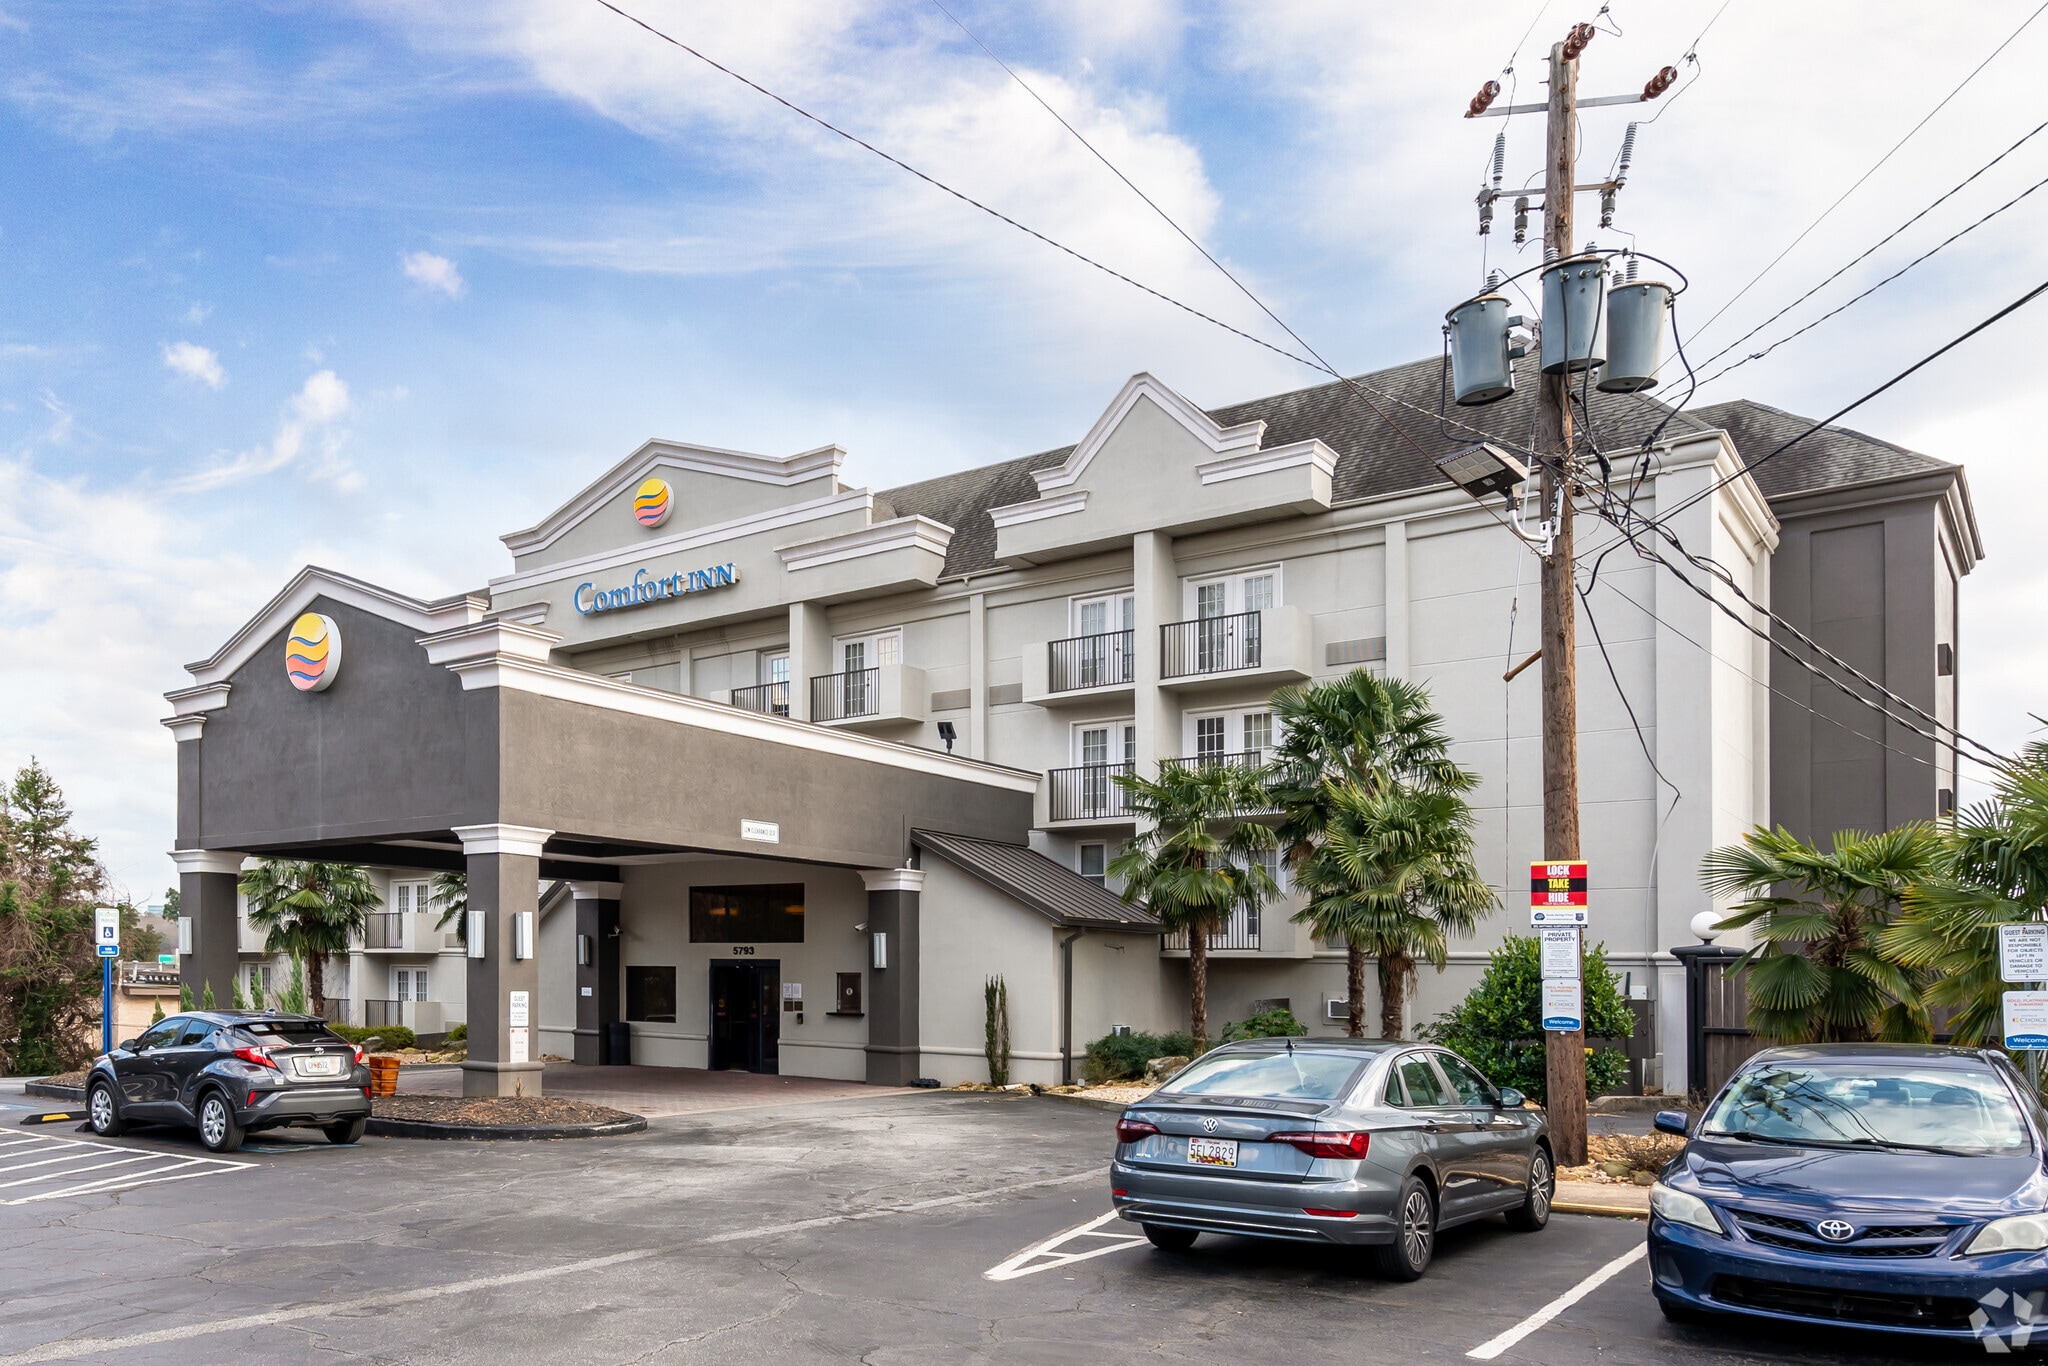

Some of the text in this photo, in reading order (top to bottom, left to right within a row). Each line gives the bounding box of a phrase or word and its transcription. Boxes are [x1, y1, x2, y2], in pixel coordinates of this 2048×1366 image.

[574, 563, 737, 615] Comfort INN
[1547, 865, 1570, 876] LOCK
[1548, 878, 1570, 889] TAKE
[1548, 892, 1569, 902] HIDE
[732, 946, 755, 955] 5793
[1190, 1143, 1235, 1161] 5EL2829
